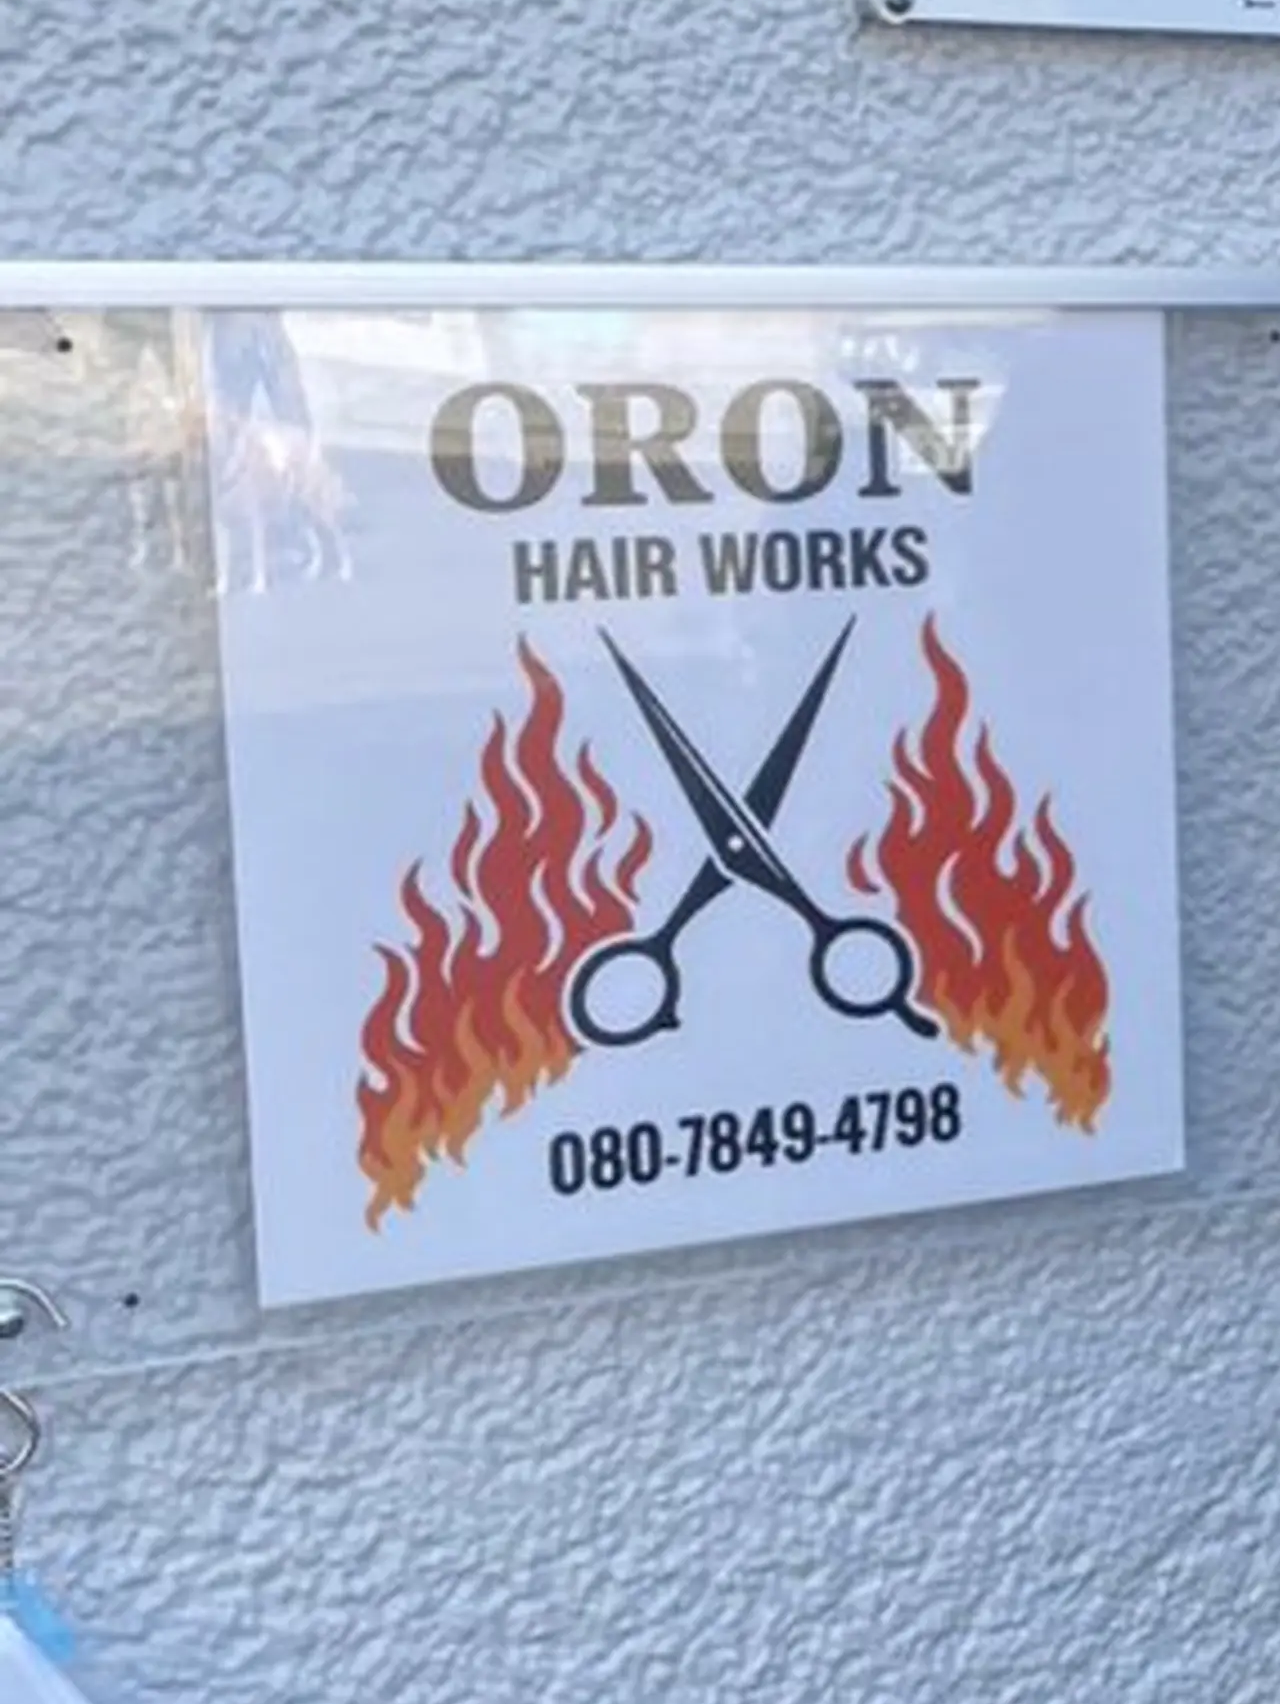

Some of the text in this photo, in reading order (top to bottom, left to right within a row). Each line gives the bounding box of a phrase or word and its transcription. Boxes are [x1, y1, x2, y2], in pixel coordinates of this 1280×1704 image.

[426, 377, 982, 513] ORON
[512, 525, 930, 604] HAIR WORKS
[549, 1083, 962, 1196] 080-7849-4798
